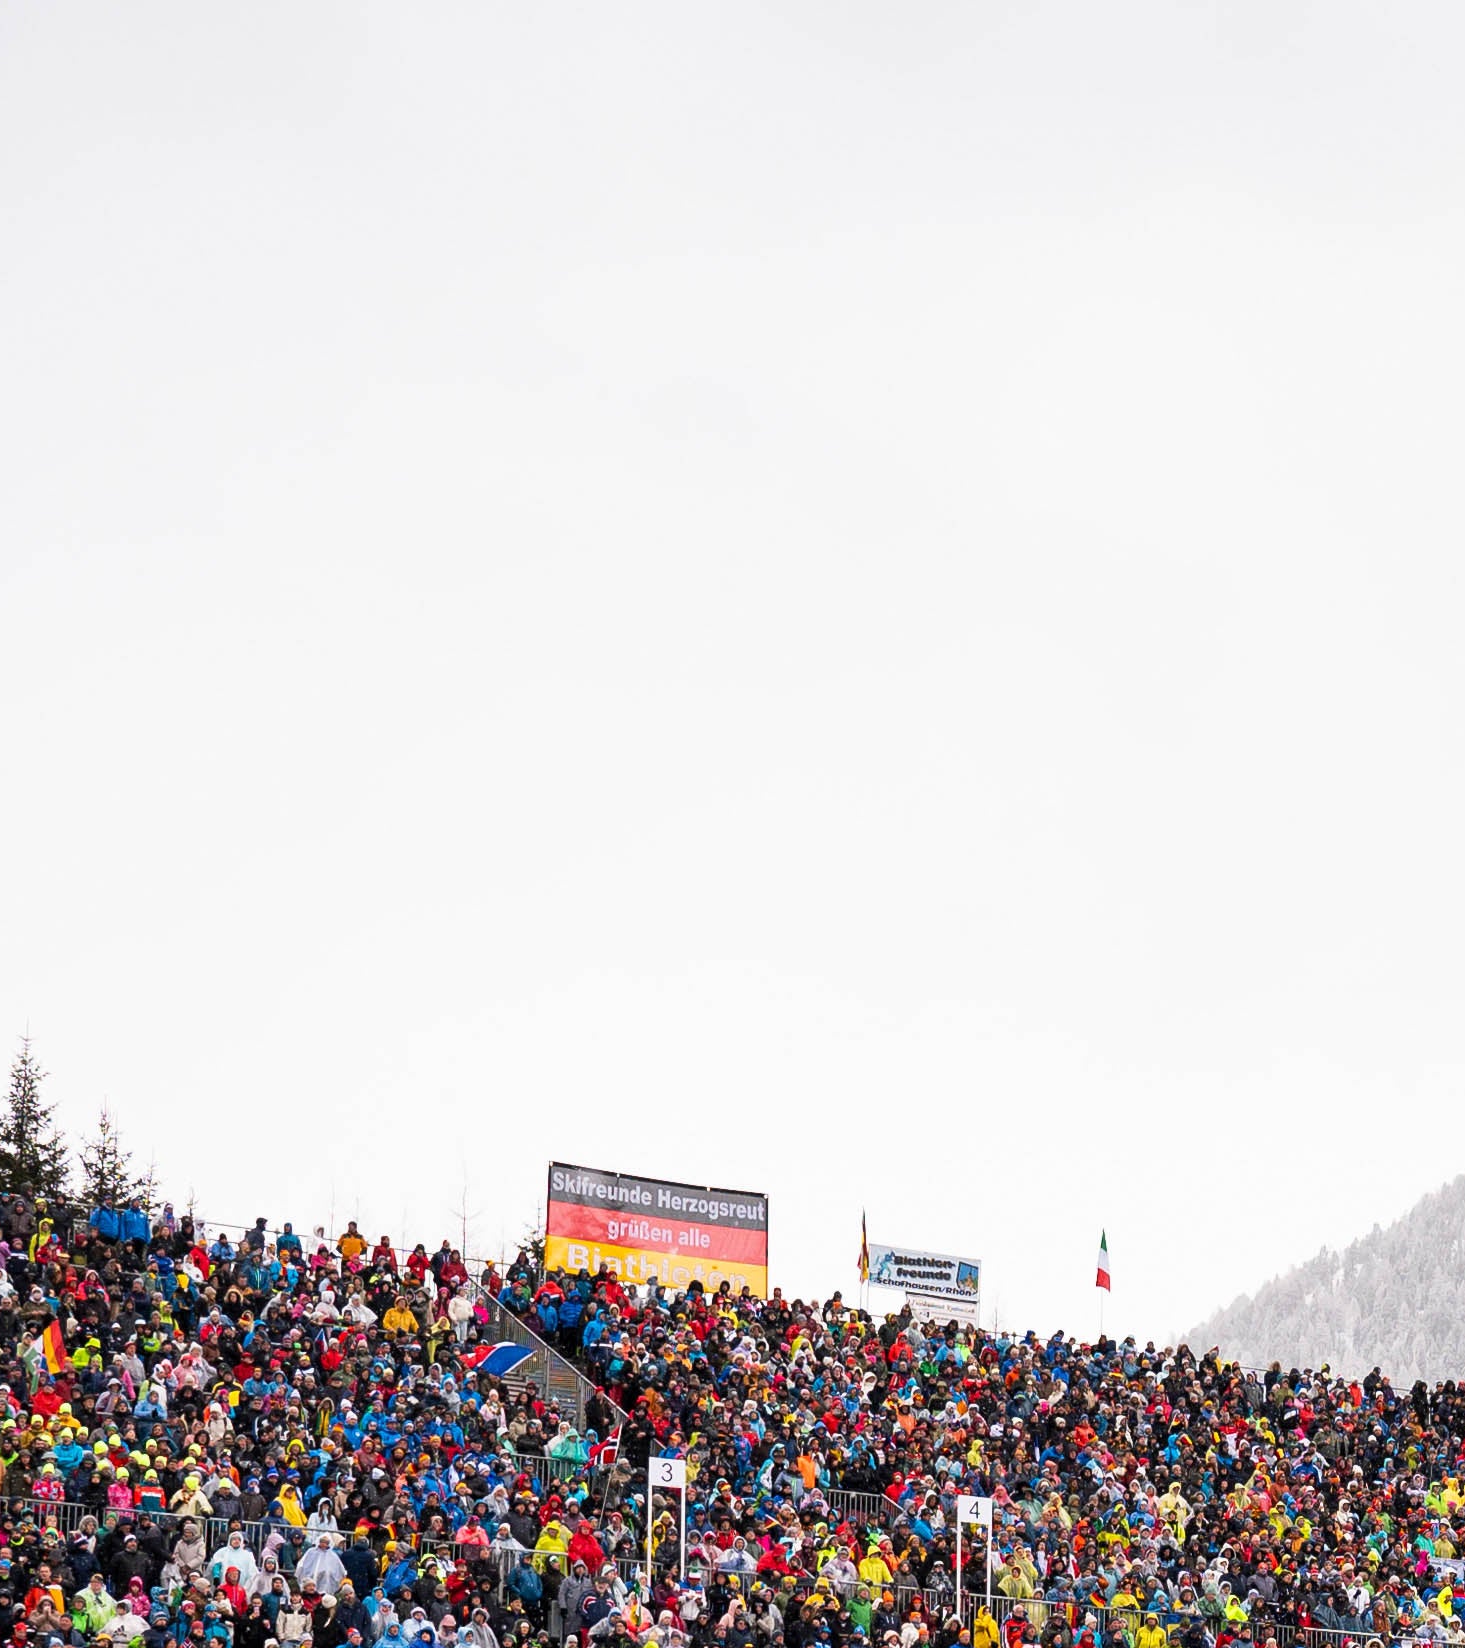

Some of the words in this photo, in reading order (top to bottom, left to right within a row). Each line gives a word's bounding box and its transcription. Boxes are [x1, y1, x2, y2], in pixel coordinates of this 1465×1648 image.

[552, 1171, 653, 1206] Skifreunde
[657, 1188, 765, 1221] Herzogsreut
[607, 1220, 673, 1244] grüßen
[678, 1228, 710, 1248] alle
[660, 1462, 674, 1483] 3
[968, 1501, 982, 1520] 4
